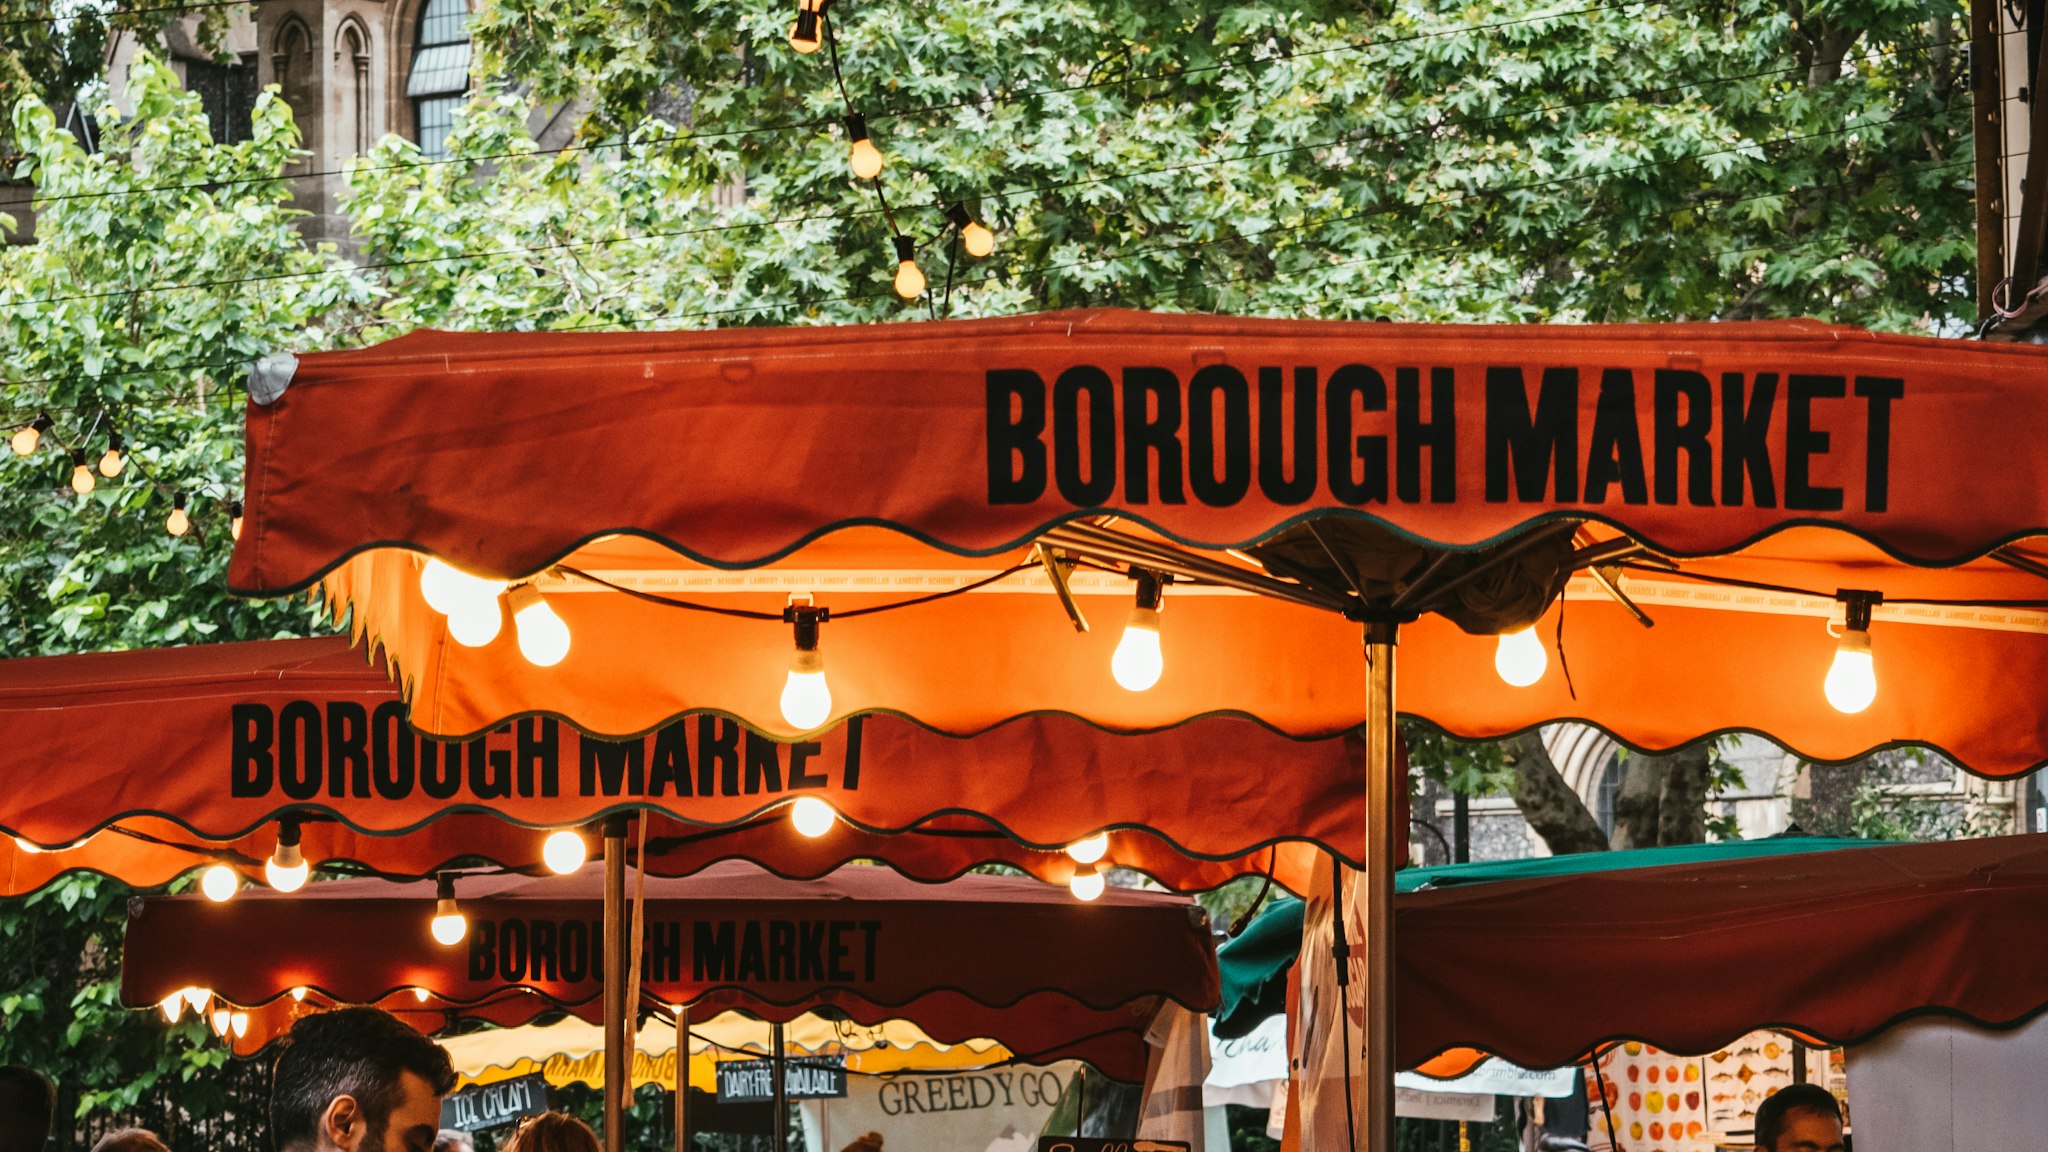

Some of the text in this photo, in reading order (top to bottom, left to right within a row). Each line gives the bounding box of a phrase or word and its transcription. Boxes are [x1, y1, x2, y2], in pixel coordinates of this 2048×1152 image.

[986, 364, 1904, 512] BOROUGH MARKET
[231, 701, 559, 800] BOROUGH
[693, 919, 882, 982] MARKET
[452, 1092, 480, 1128] ICE
[481, 1080, 532, 1119] CREAM
[879, 1072, 1014, 1116] GREEDY
